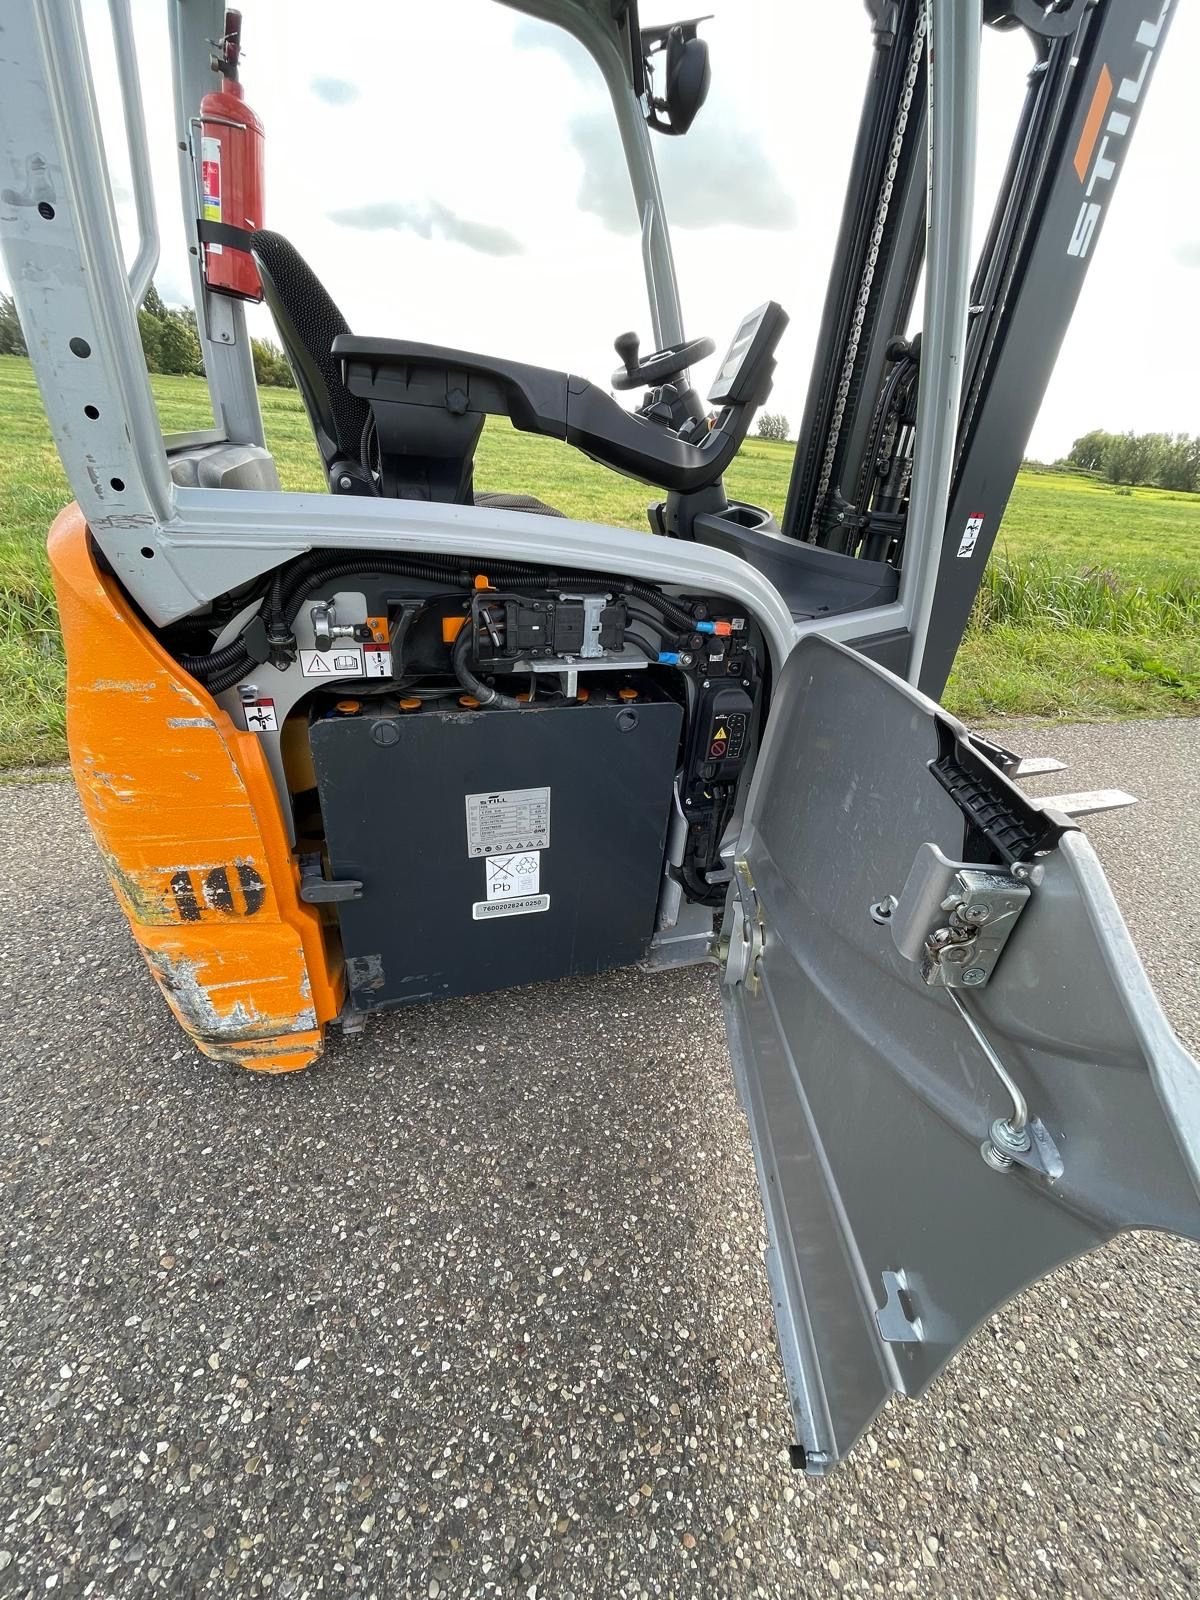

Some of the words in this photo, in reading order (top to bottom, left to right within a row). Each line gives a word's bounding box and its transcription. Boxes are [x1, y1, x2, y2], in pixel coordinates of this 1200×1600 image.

[1067, 0, 1171, 258] STILL
[480, 797, 507, 805] STILL
[169, 865, 265, 921] 10
[492, 883, 511, 893] Pb
